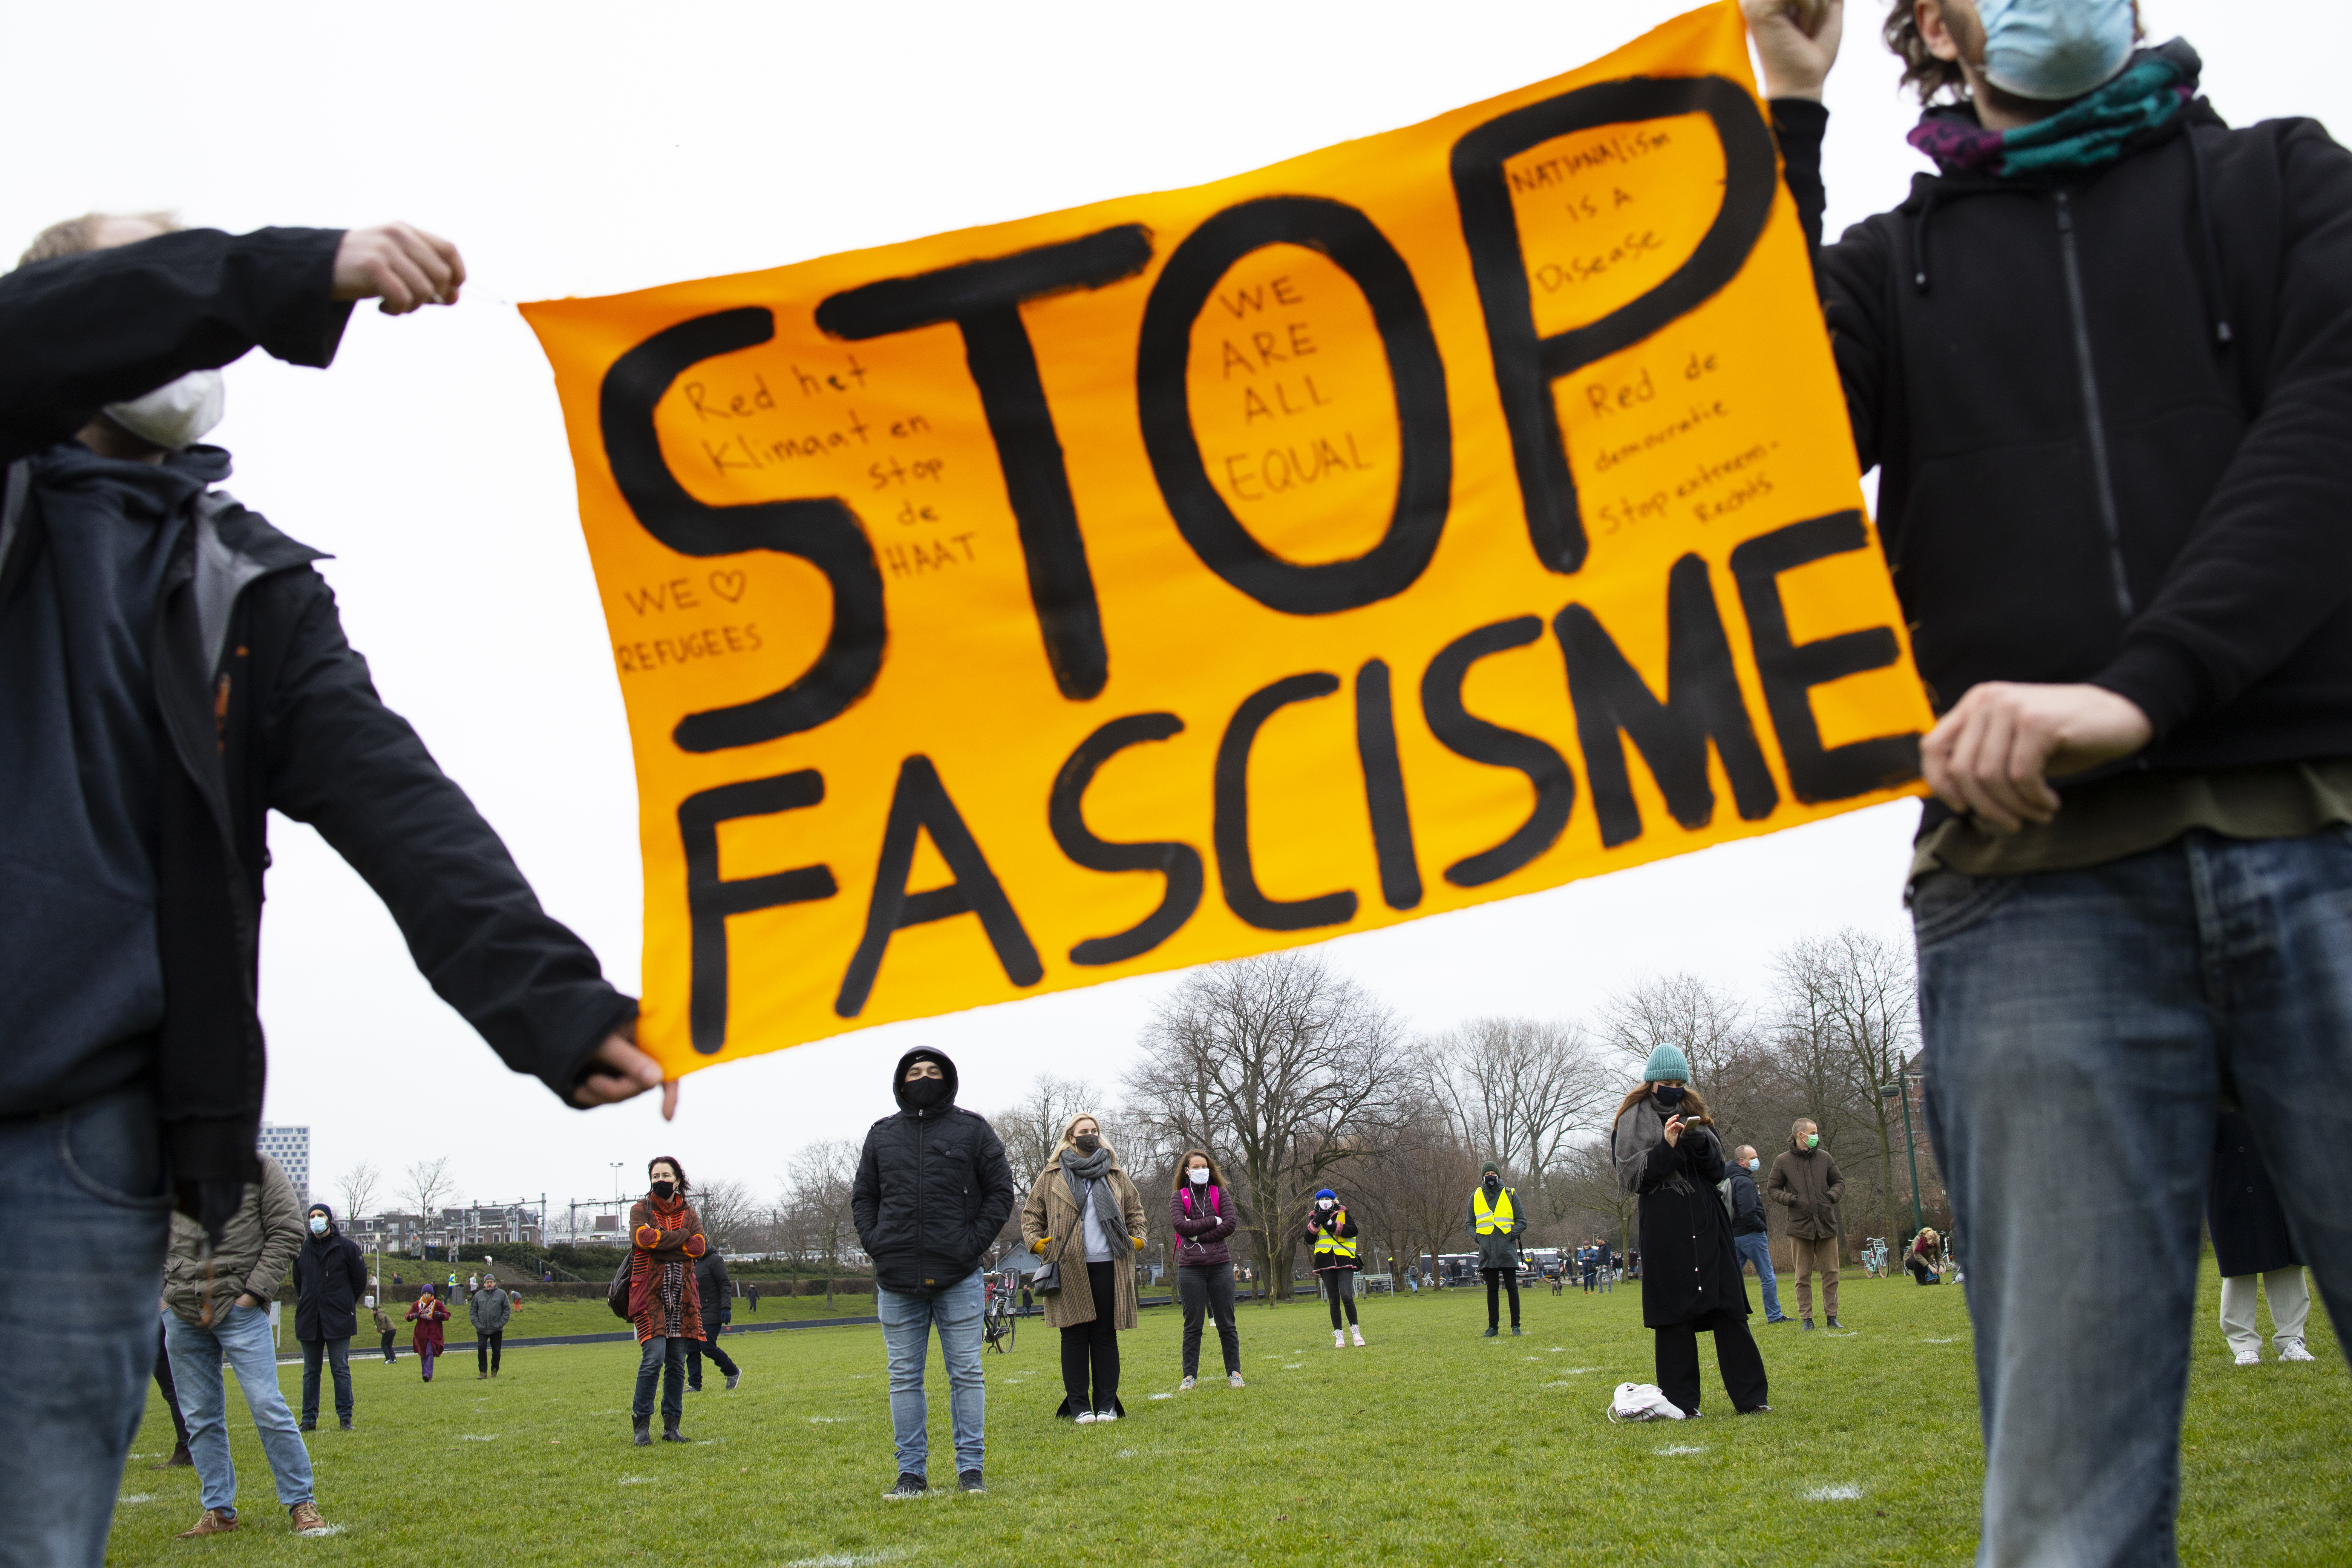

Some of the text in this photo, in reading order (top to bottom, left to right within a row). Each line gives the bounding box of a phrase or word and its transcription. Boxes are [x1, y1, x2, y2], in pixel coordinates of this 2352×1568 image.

[1612, 186, 1633, 210] A
[1219, 274, 1304, 320] WE
[1221, 322, 1318, 381] ARE
[599, 74, 1780, 754] STOP
[682, 353, 869, 423] Red het
[1243, 375, 1333, 427] ALL
[1584, 352, 1718, 419] Red de
[701, 408, 933, 478] Klimaat en
[1224, 430, 1375, 502] EQUAL
[896, 499, 940, 527] de
[884, 531, 977, 579] HAAT
[622, 576, 701, 617] WE
[616, 622, 763, 677] REFUGEES
[678, 509, 1924, 1055] FASCISME
